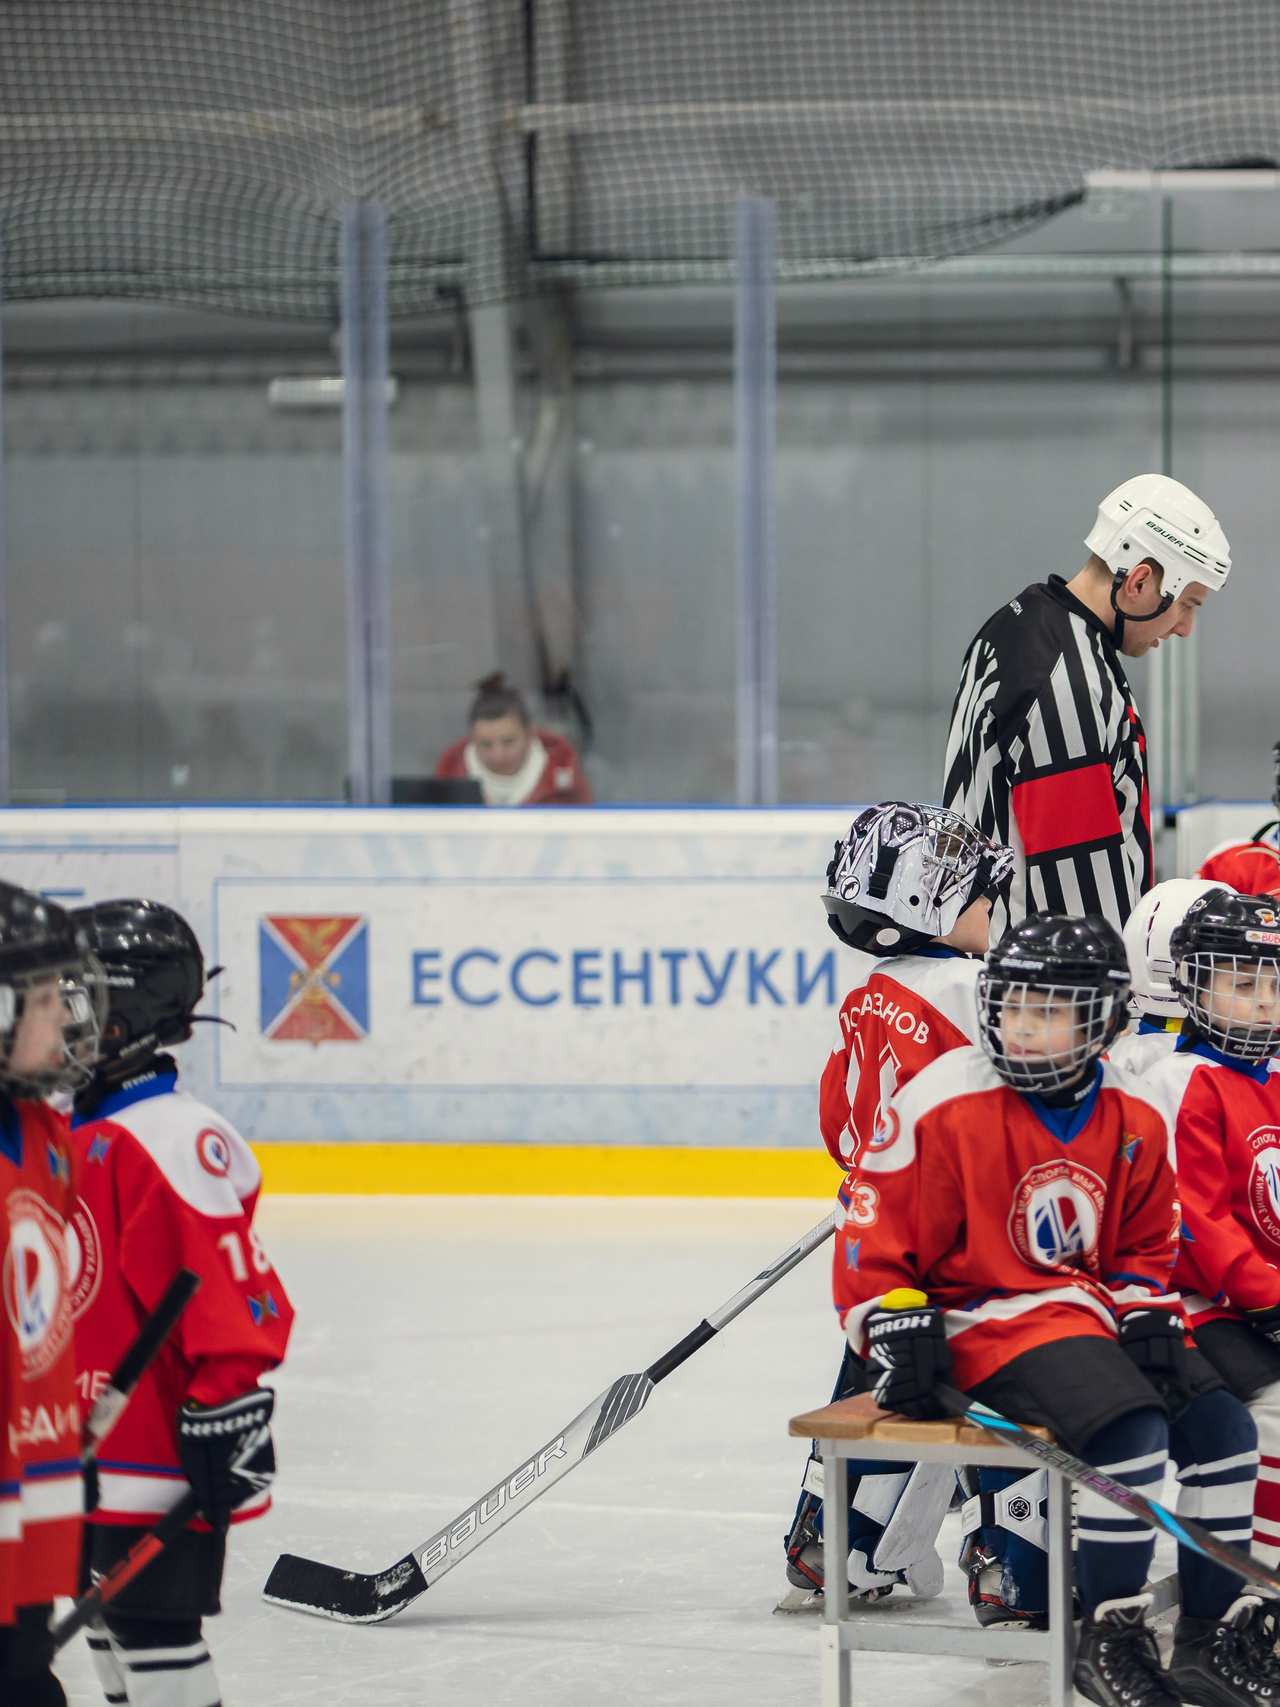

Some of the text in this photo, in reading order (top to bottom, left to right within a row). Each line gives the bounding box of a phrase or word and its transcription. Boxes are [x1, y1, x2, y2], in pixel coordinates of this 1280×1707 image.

[1146, 520, 1184, 547] BAUER
[410, 948, 838, 1007] ЕССЕНТУКИ
[421, 1436, 568, 1575] BAUER
